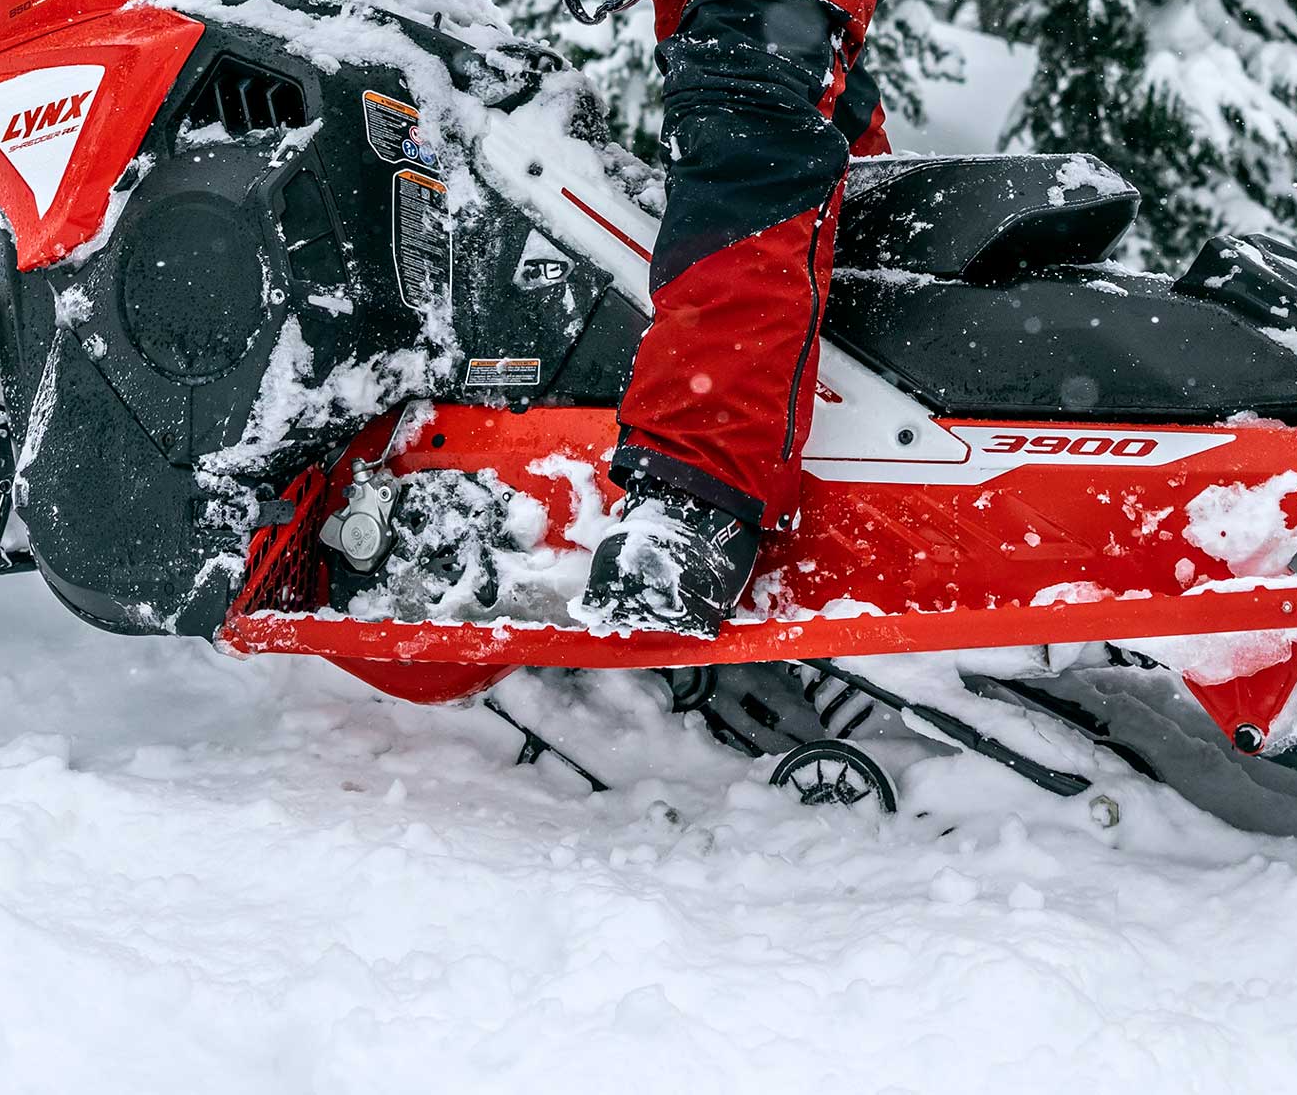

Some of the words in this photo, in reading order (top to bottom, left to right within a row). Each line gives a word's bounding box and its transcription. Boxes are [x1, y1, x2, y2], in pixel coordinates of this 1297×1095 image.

[1, 90, 93, 143] LYNX
[8, 130, 62, 153] SHREDDER
[982, 435, 1159, 457] 3900
